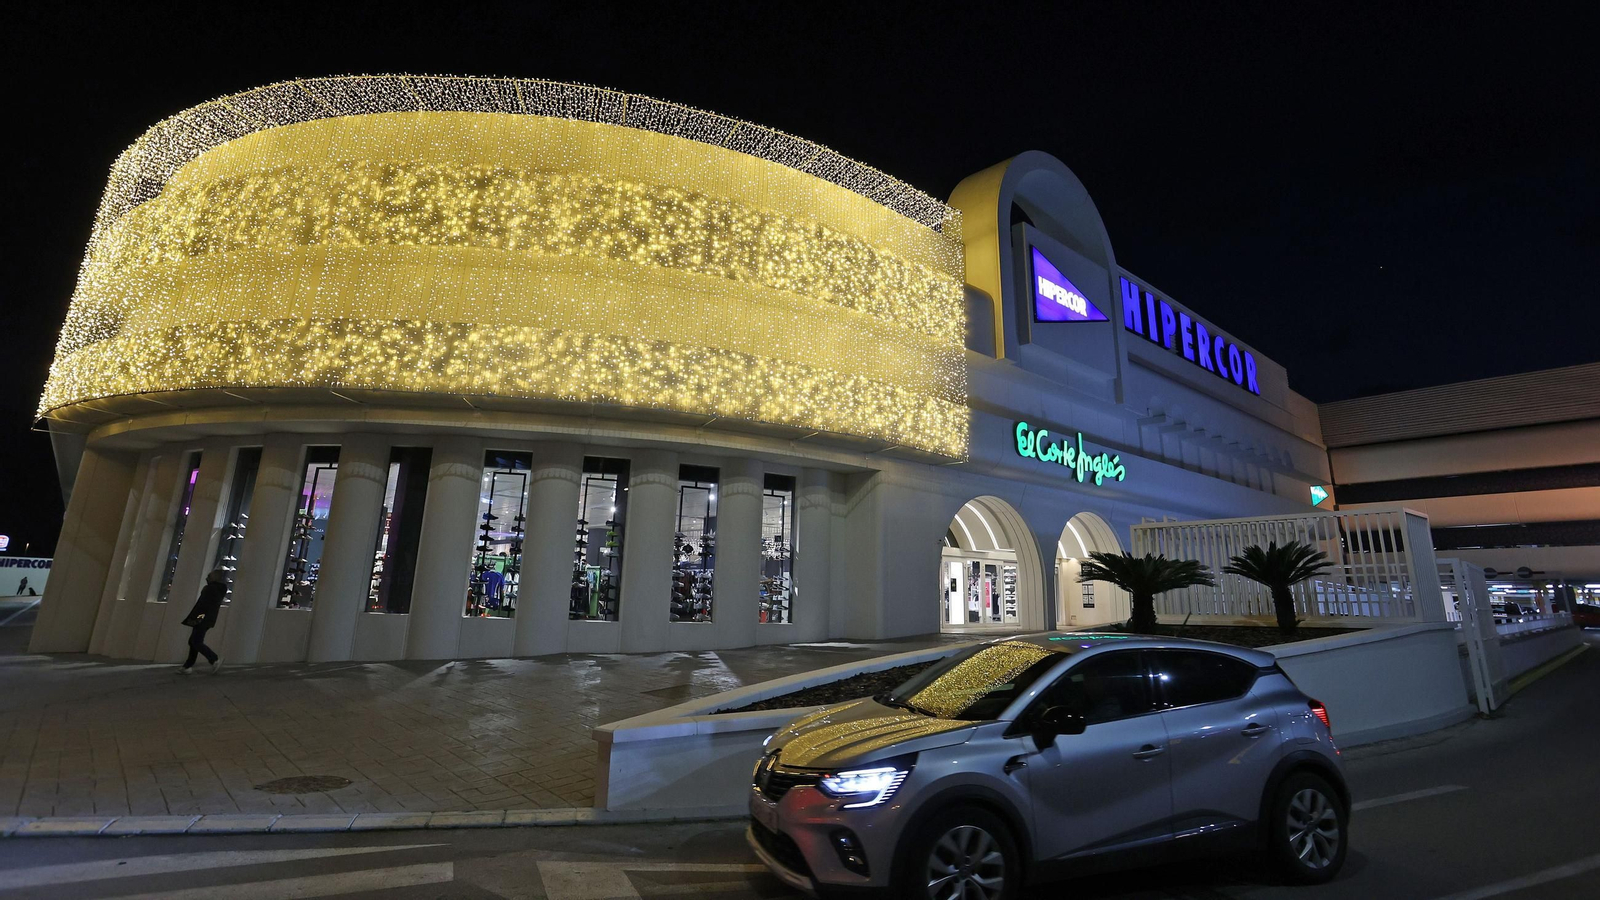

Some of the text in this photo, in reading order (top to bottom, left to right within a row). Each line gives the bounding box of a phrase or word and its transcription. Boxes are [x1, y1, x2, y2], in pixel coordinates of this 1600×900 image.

[1037, 275, 1088, 317] HIPERCOR
[1119, 275, 1261, 396] HIPERCOR
[1016, 421, 1126, 486] El Corte Inglés
